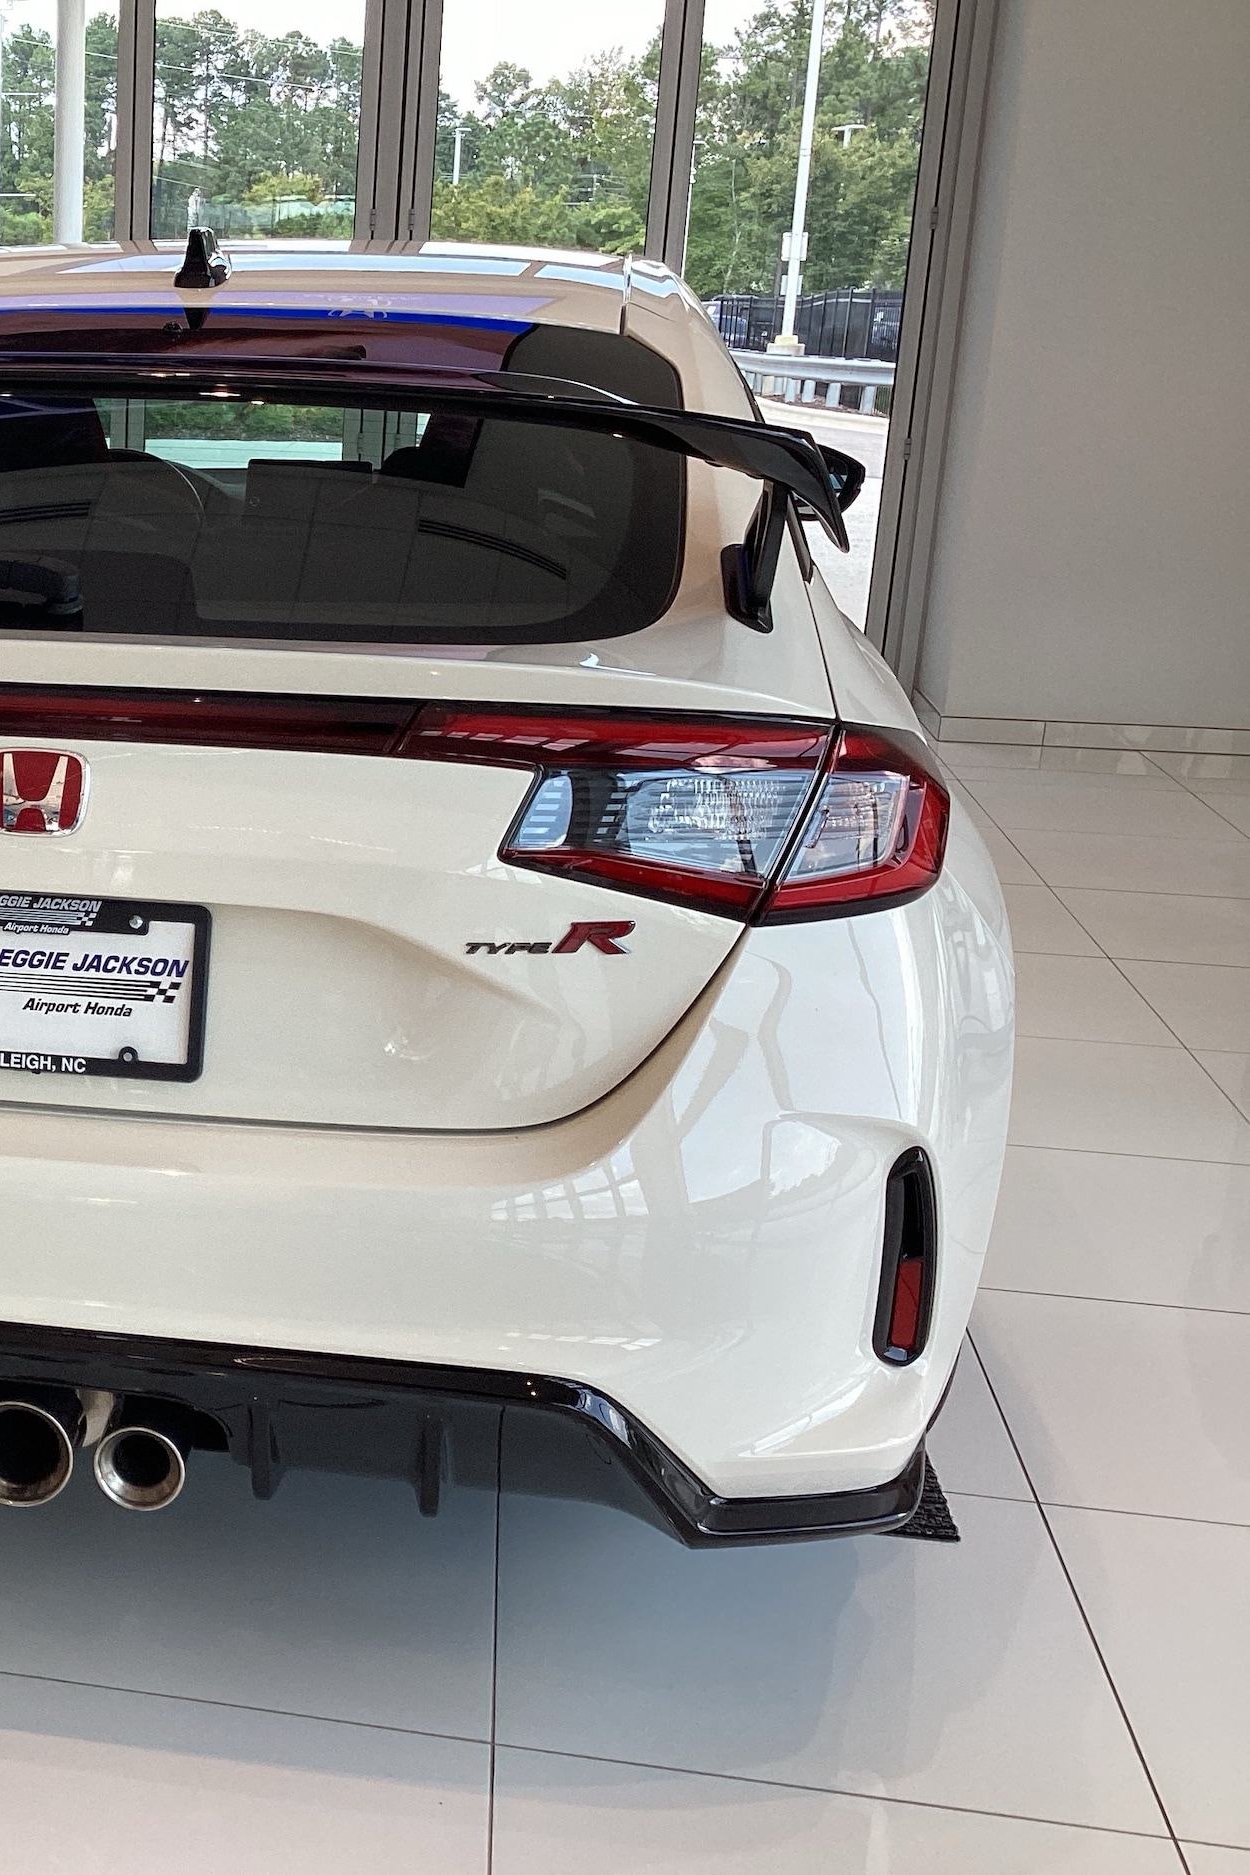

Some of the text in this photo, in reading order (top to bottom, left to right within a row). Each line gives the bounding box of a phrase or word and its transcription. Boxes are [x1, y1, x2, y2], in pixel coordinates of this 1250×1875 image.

[32, 896, 102, 913] JACKSON
[4, 921, 69, 935] Airport Honda
[465, 920, 637, 955] TYPE R
[72, 954, 190, 978] JACKSON
[23, 998, 133, 1018] Airport Honda
[61, 1057, 86, 1074] NC
